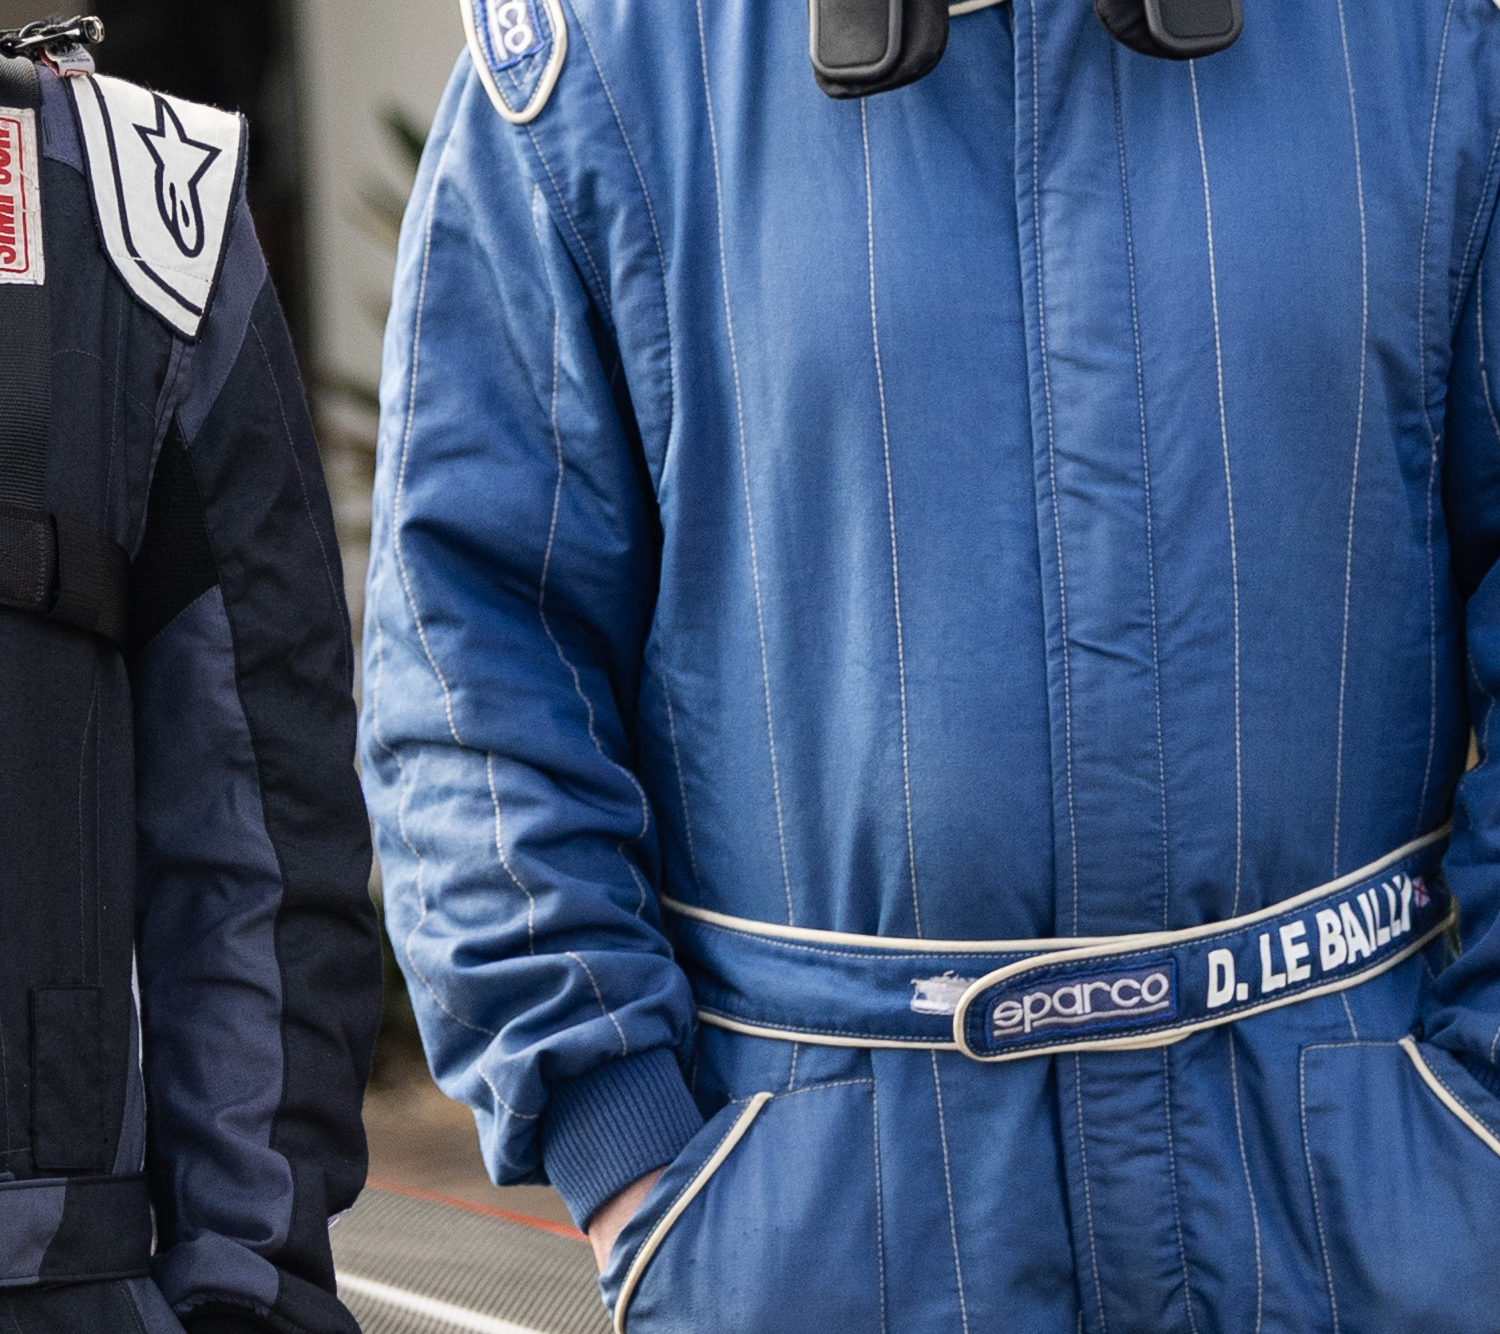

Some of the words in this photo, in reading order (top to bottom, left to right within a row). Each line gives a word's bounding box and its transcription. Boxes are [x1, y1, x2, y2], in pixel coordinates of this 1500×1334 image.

[993, 972, 1169, 1033] sparco
[1207, 948, 1249, 1009] D.
[1259, 920, 1312, 993] LE
[1315, 871, 1413, 972] BAILLY
